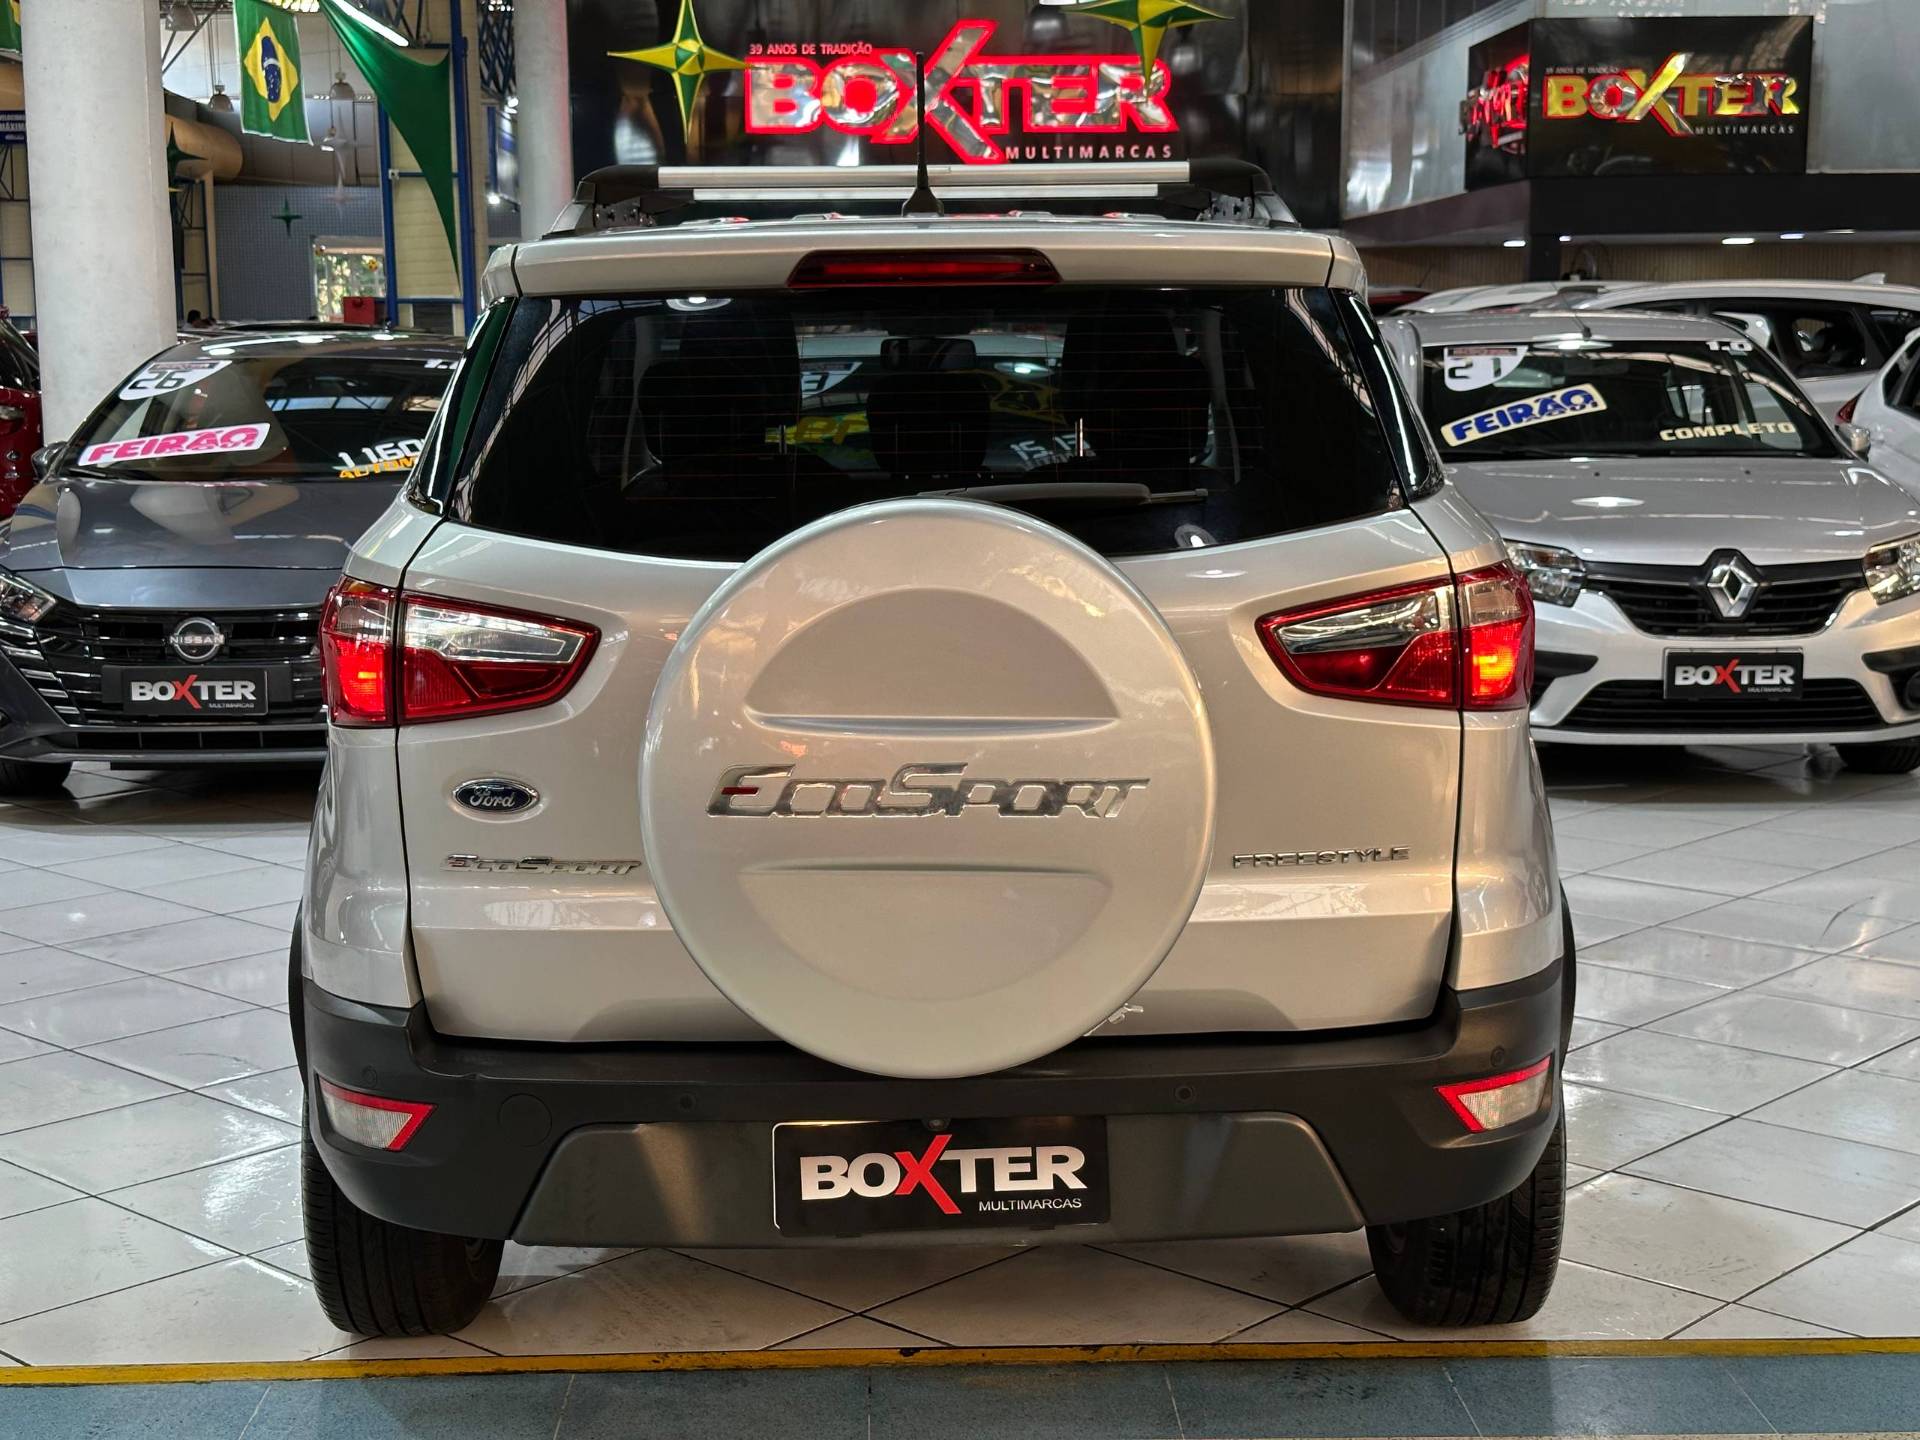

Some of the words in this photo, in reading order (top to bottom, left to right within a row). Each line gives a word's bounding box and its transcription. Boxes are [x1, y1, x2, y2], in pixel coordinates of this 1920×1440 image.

[749, 44, 763, 55] 39
[767, 44, 797, 55] ANOS
[801, 44, 816, 55] DE
[820, 42, 873, 56] TRADIÇÃO
[744, 18, 1179, 164] BOXTER
[1543, 51, 1800, 136] BOXTER
[1694, 124, 1795, 135] MULTIMARCAS
[1006, 145, 1172, 160] MULTIMARCAS
[128, 369, 193, 389] 26
[1451, 388, 1595, 441] FEIRÃO
[1659, 422, 1796, 441] COMPLETO
[88, 427, 258, 462] FEIRÃO
[170, 634, 225, 645] NISSAN
[1674, 658, 1795, 693] BOXTER
[130, 674, 257, 709] BOXTER
[470, 785, 515, 807] Ford
[1232, 845, 1411, 869] FREESTYLE
[800, 1134, 1088, 1215] BOXTER
[979, 1197, 1082, 1211] MULTIMARCAS
